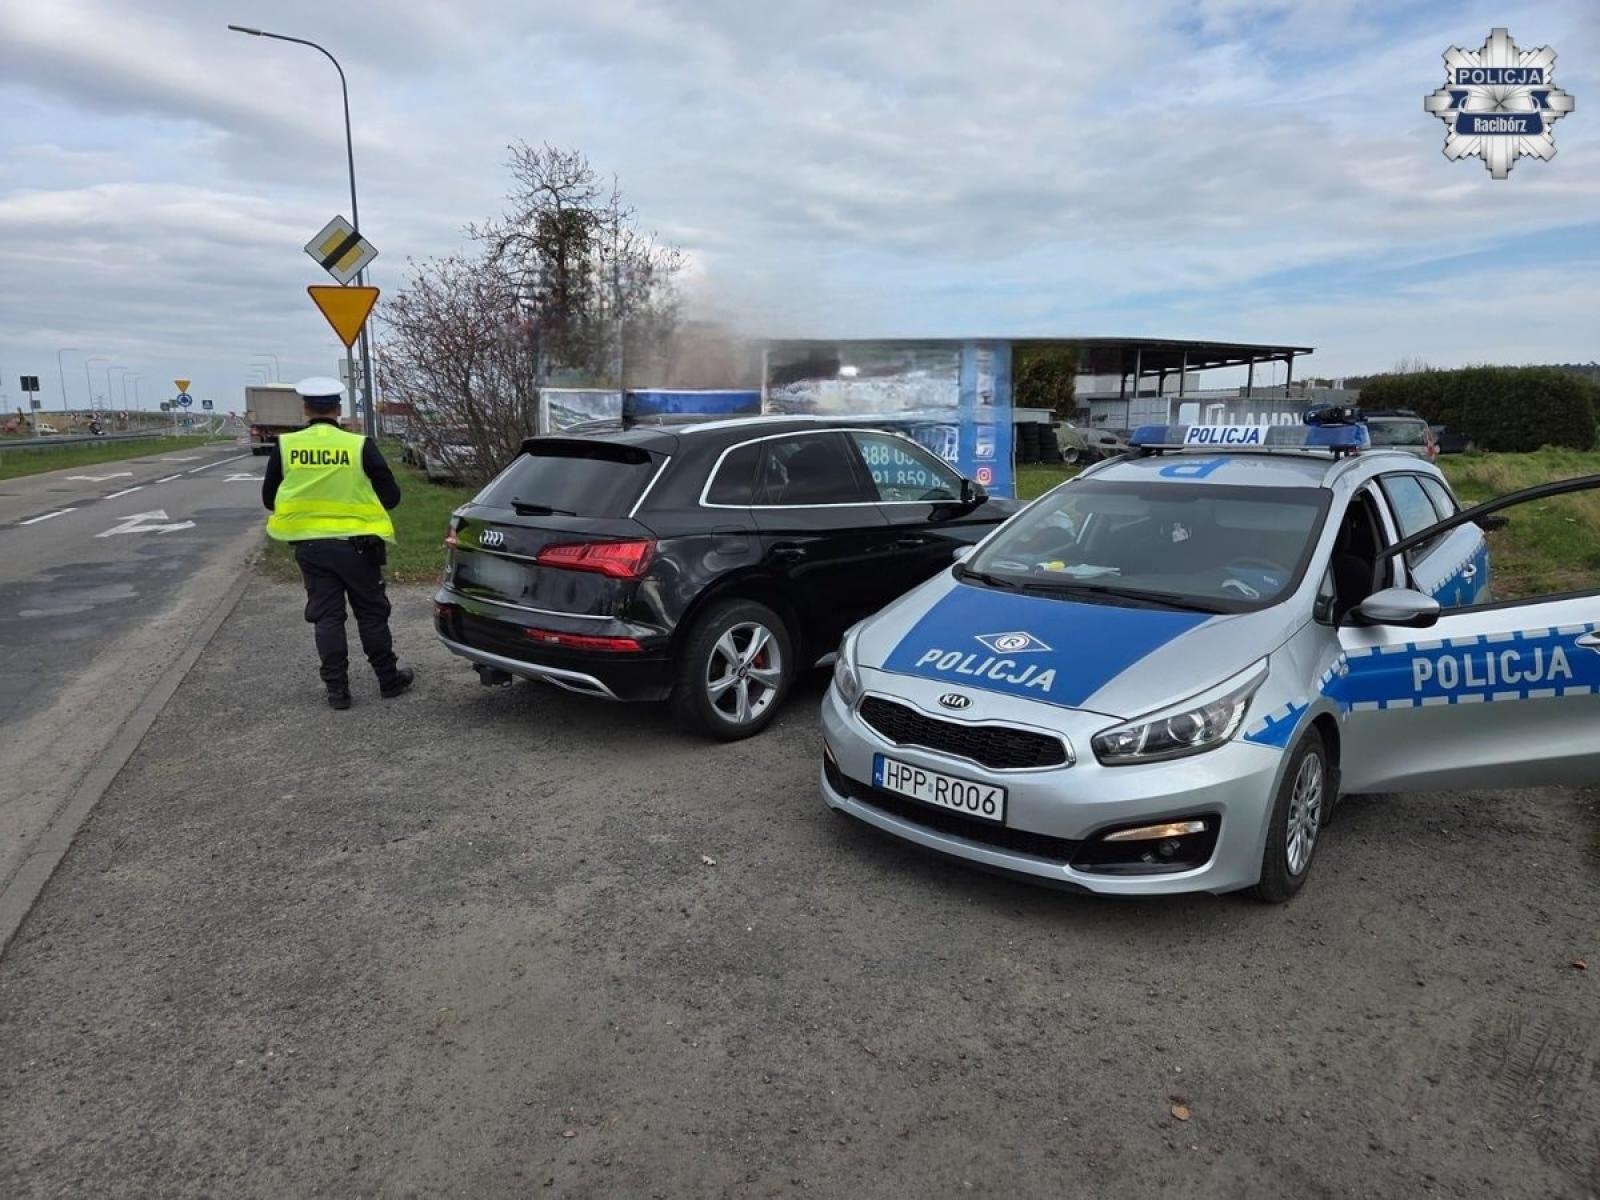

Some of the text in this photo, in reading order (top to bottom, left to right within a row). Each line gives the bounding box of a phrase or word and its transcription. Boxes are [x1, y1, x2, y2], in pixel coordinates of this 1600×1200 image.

[1187, 427, 1260, 444] POLICJA
[290, 449, 350, 465] POLICJA
[914, 648, 1057, 692] POLICJA
[1411, 645, 1573, 692] POLICJA
[942, 694, 966, 708] KIA
[887, 761, 996, 815] HPP R006
